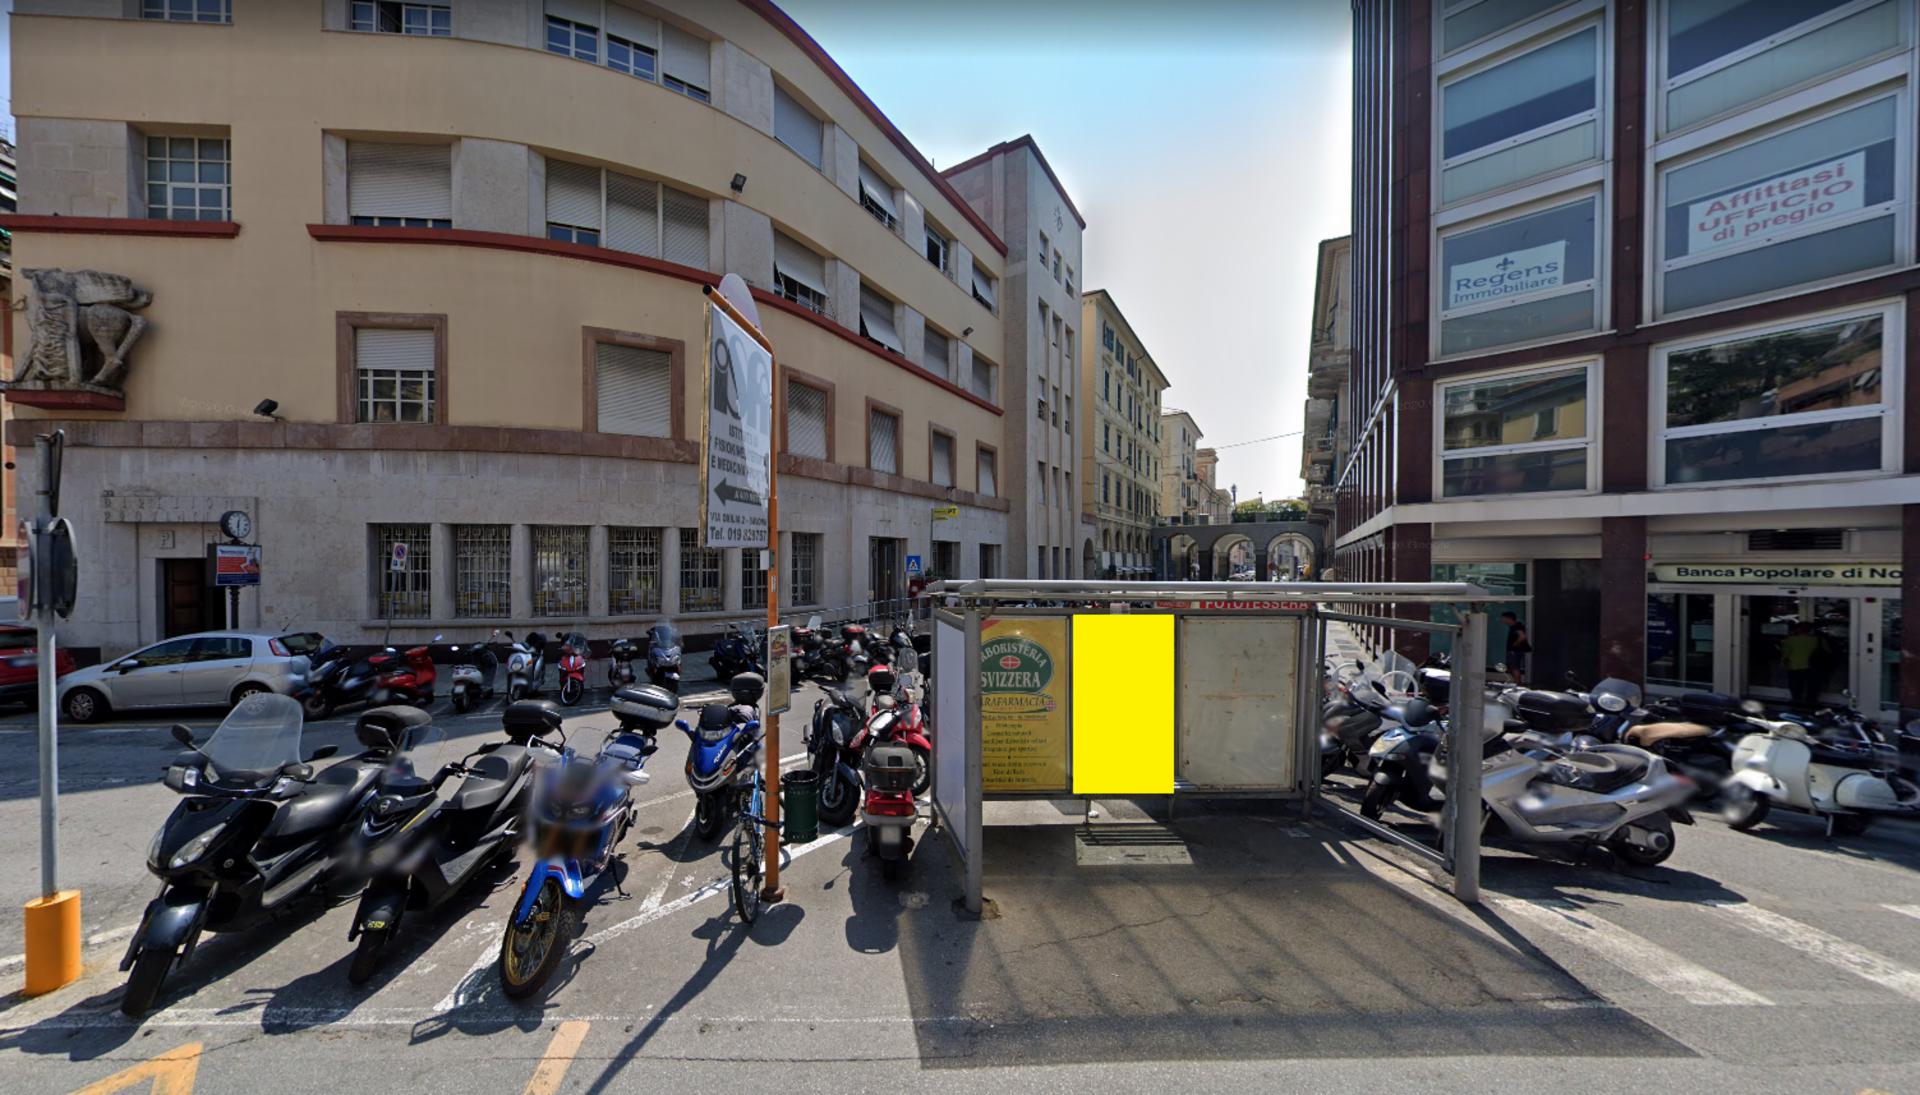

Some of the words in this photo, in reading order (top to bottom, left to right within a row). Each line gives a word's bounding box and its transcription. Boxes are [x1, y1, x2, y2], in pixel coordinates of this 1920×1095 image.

[1705, 162, 1845, 216] Affittasi
[1698, 180, 1854, 232] UFFICIO
[1712, 226, 1735, 242] di
[1744, 201, 1835, 237] pregio
[1454, 276, 1558, 303] Immobiliare
[1456, 262, 1559, 291] Regens
[710, 526, 724, 540] Tel.
[727, 527, 742, 541] 019
[1676, 567, 1735, 577] Banca
[1740, 567, 1835, 580] Popolare
[1841, 567, 1863, 578] di
[1869, 568, 1903, 579] No
[981, 642, 1047, 668] RBORISTERIA
[981, 671, 1041, 688] SVIZZERA
